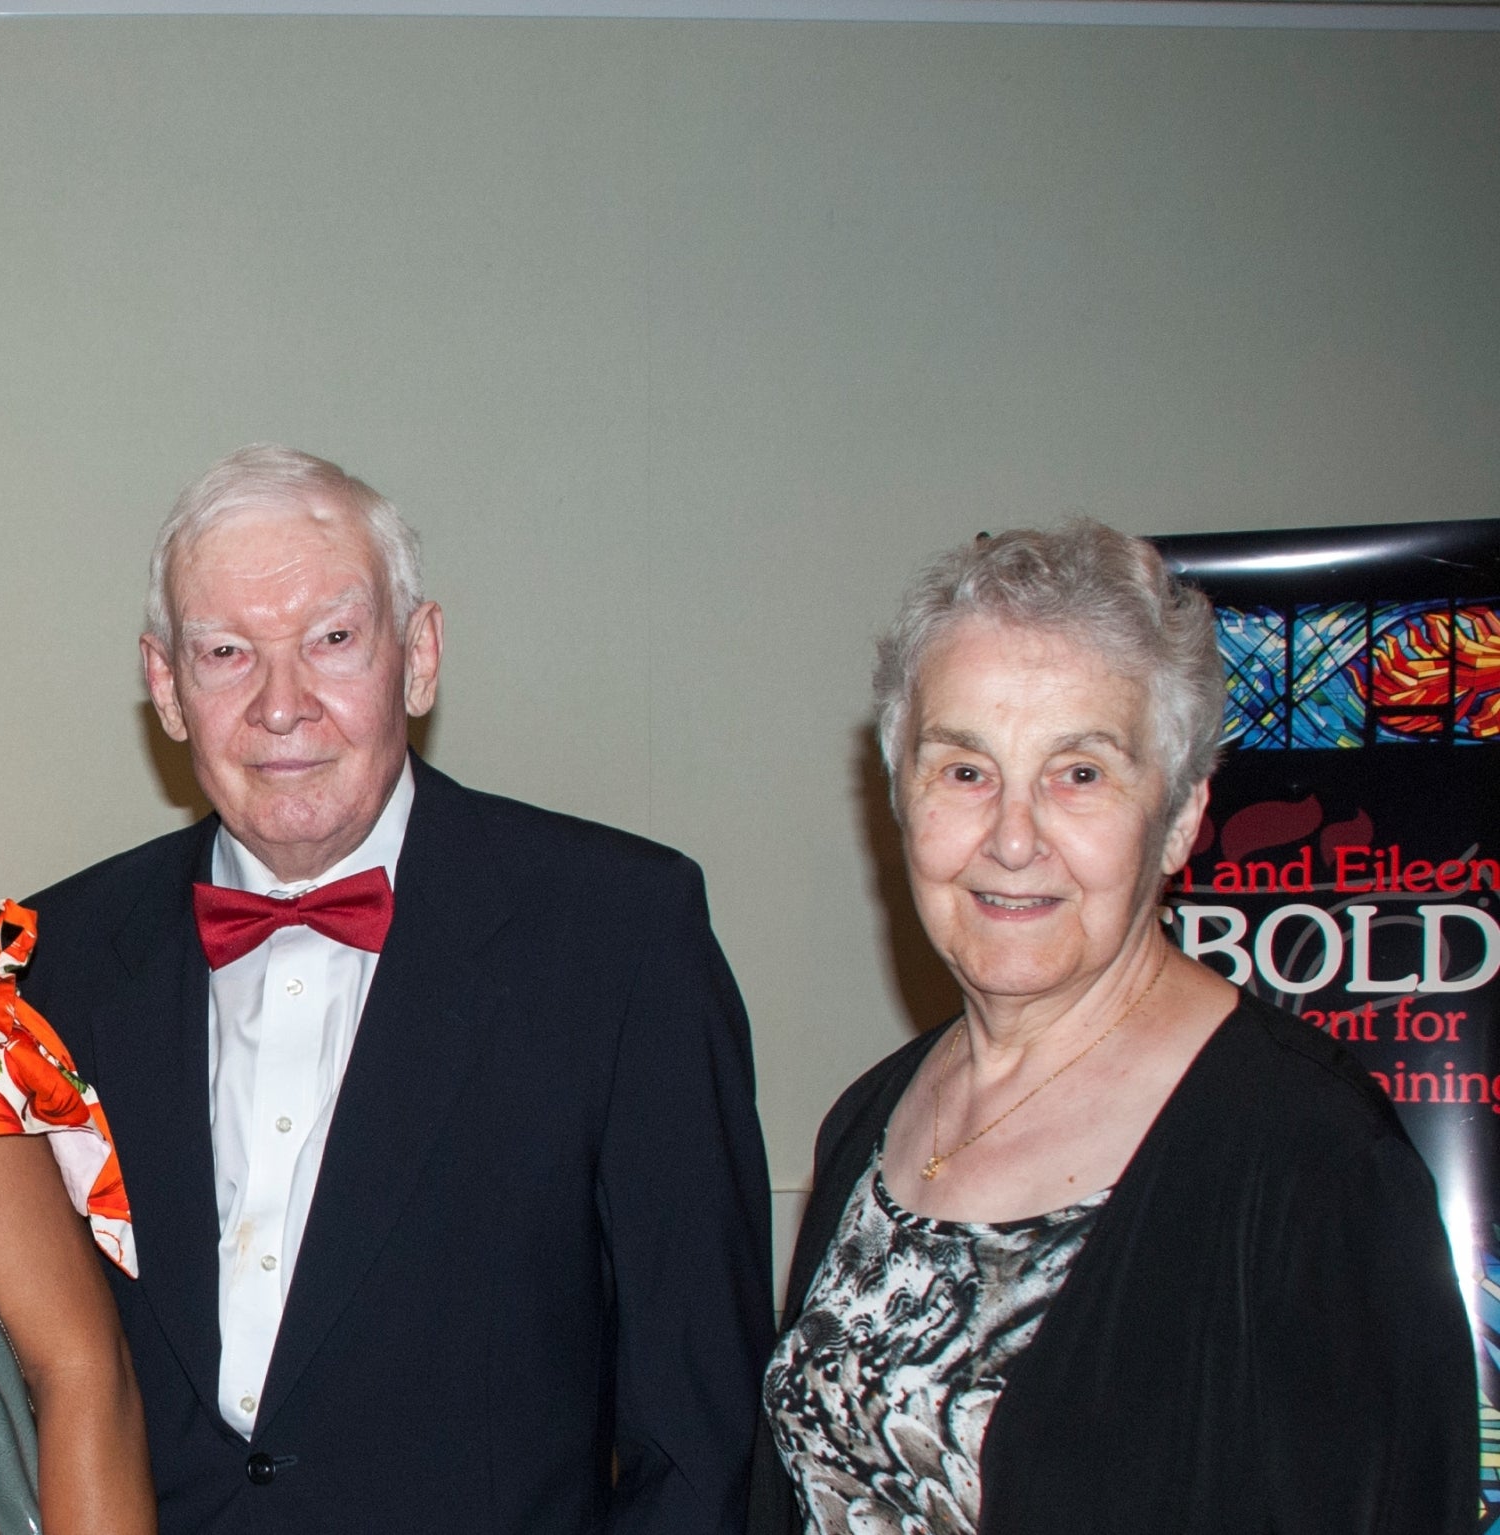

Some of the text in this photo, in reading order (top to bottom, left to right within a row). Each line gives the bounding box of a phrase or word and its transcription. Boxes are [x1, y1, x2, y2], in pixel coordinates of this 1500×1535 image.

[1212, 846, 1314, 894] and
[1333, 845, 1500, 894] Eileen
[1161, 903, 1500, 994] BOLD
[1393, 996, 1467, 1042] for
